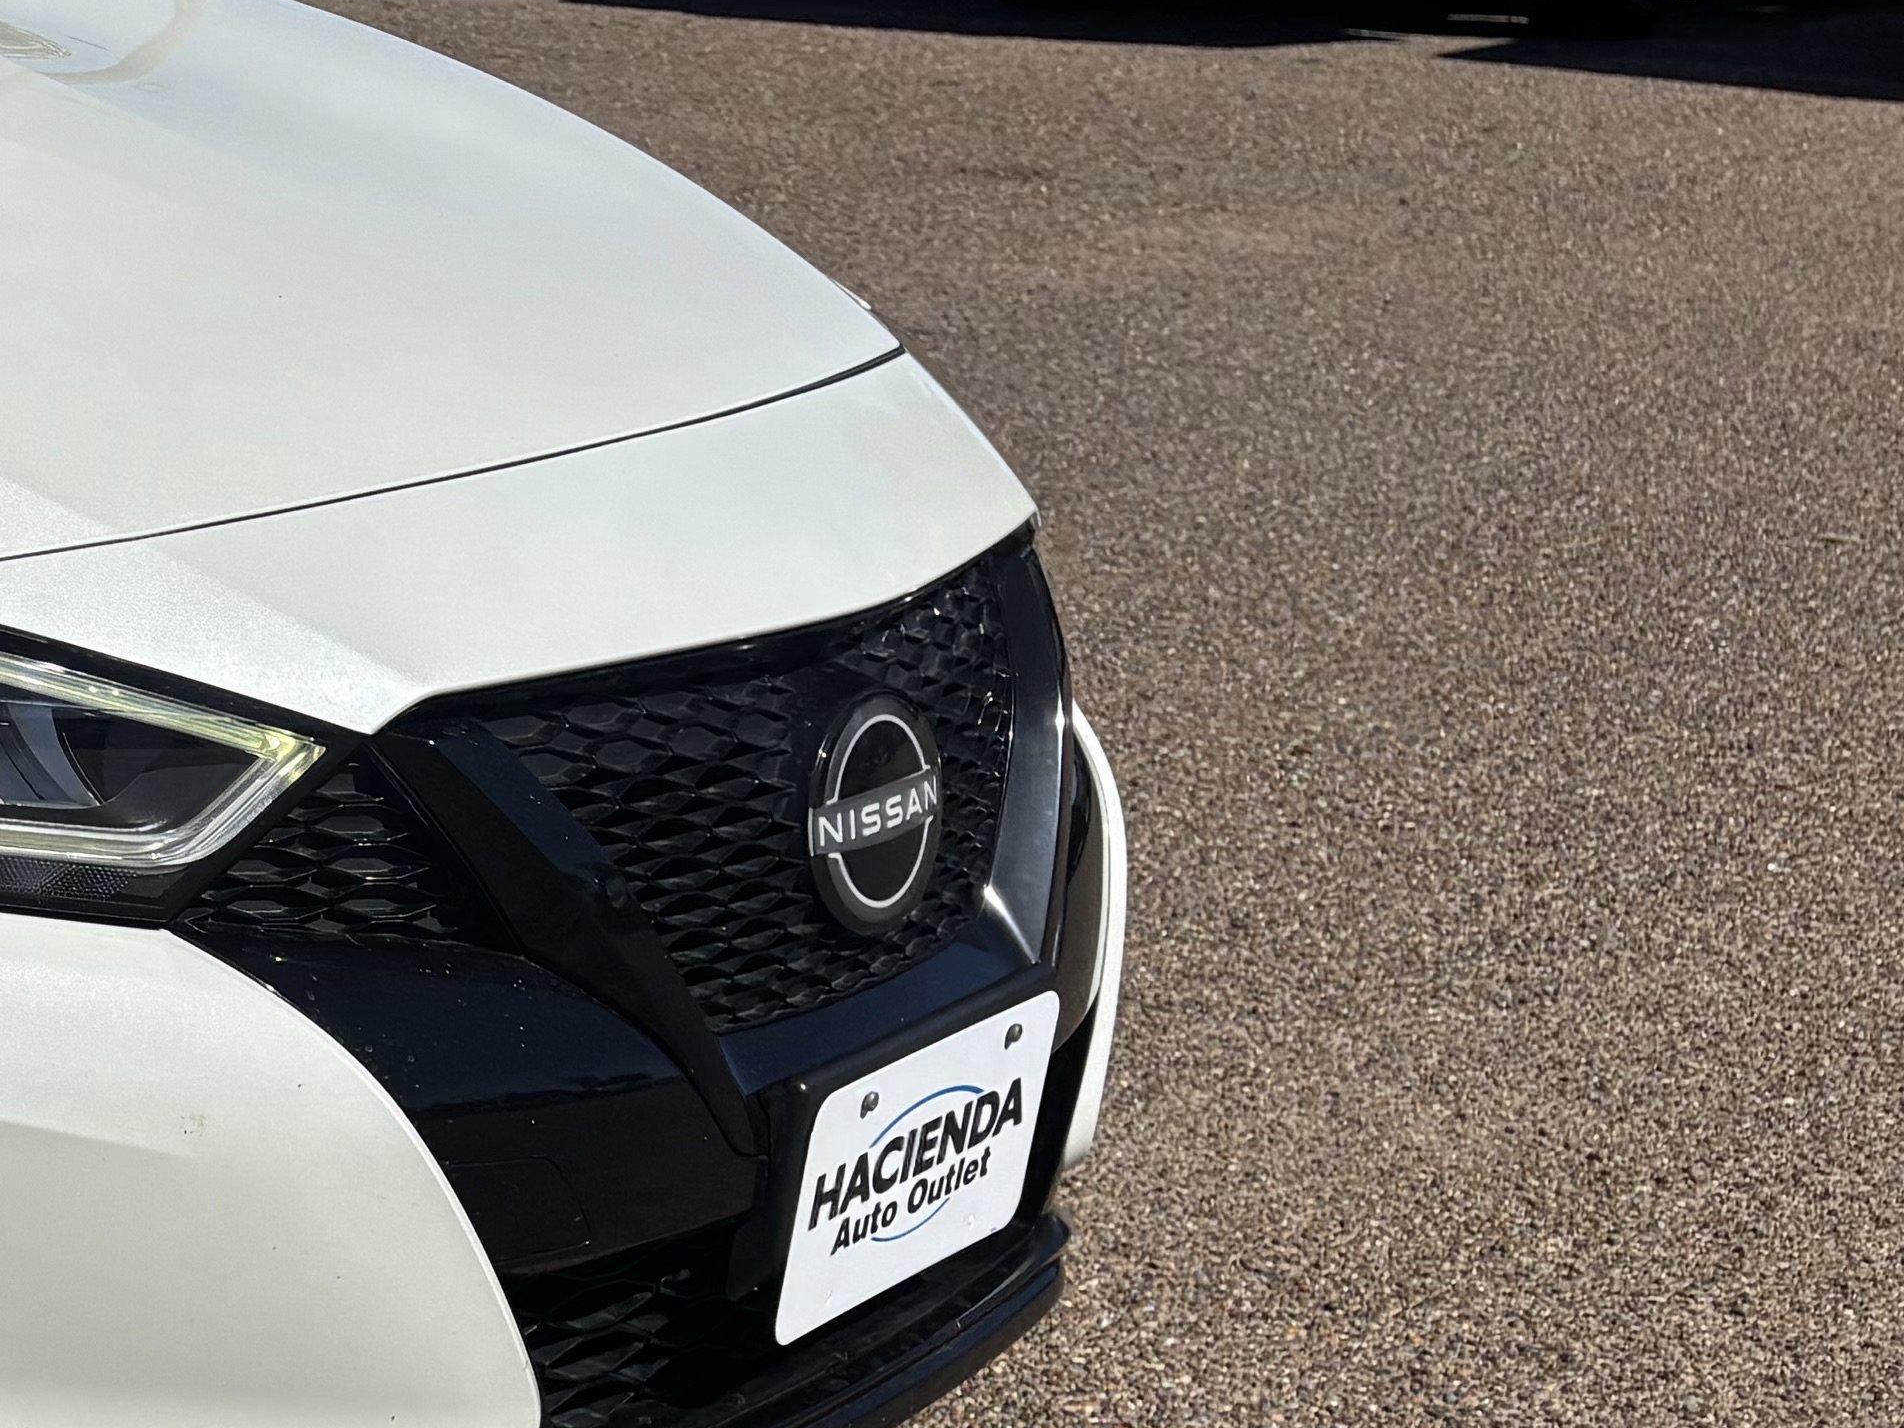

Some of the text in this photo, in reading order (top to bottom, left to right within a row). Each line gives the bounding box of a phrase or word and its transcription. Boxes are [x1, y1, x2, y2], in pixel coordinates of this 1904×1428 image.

[817, 773, 938, 847] NISSAN
[808, 1076, 1023, 1232] HACIENDA
[830, 1145, 991, 1257] Auto Outlet
